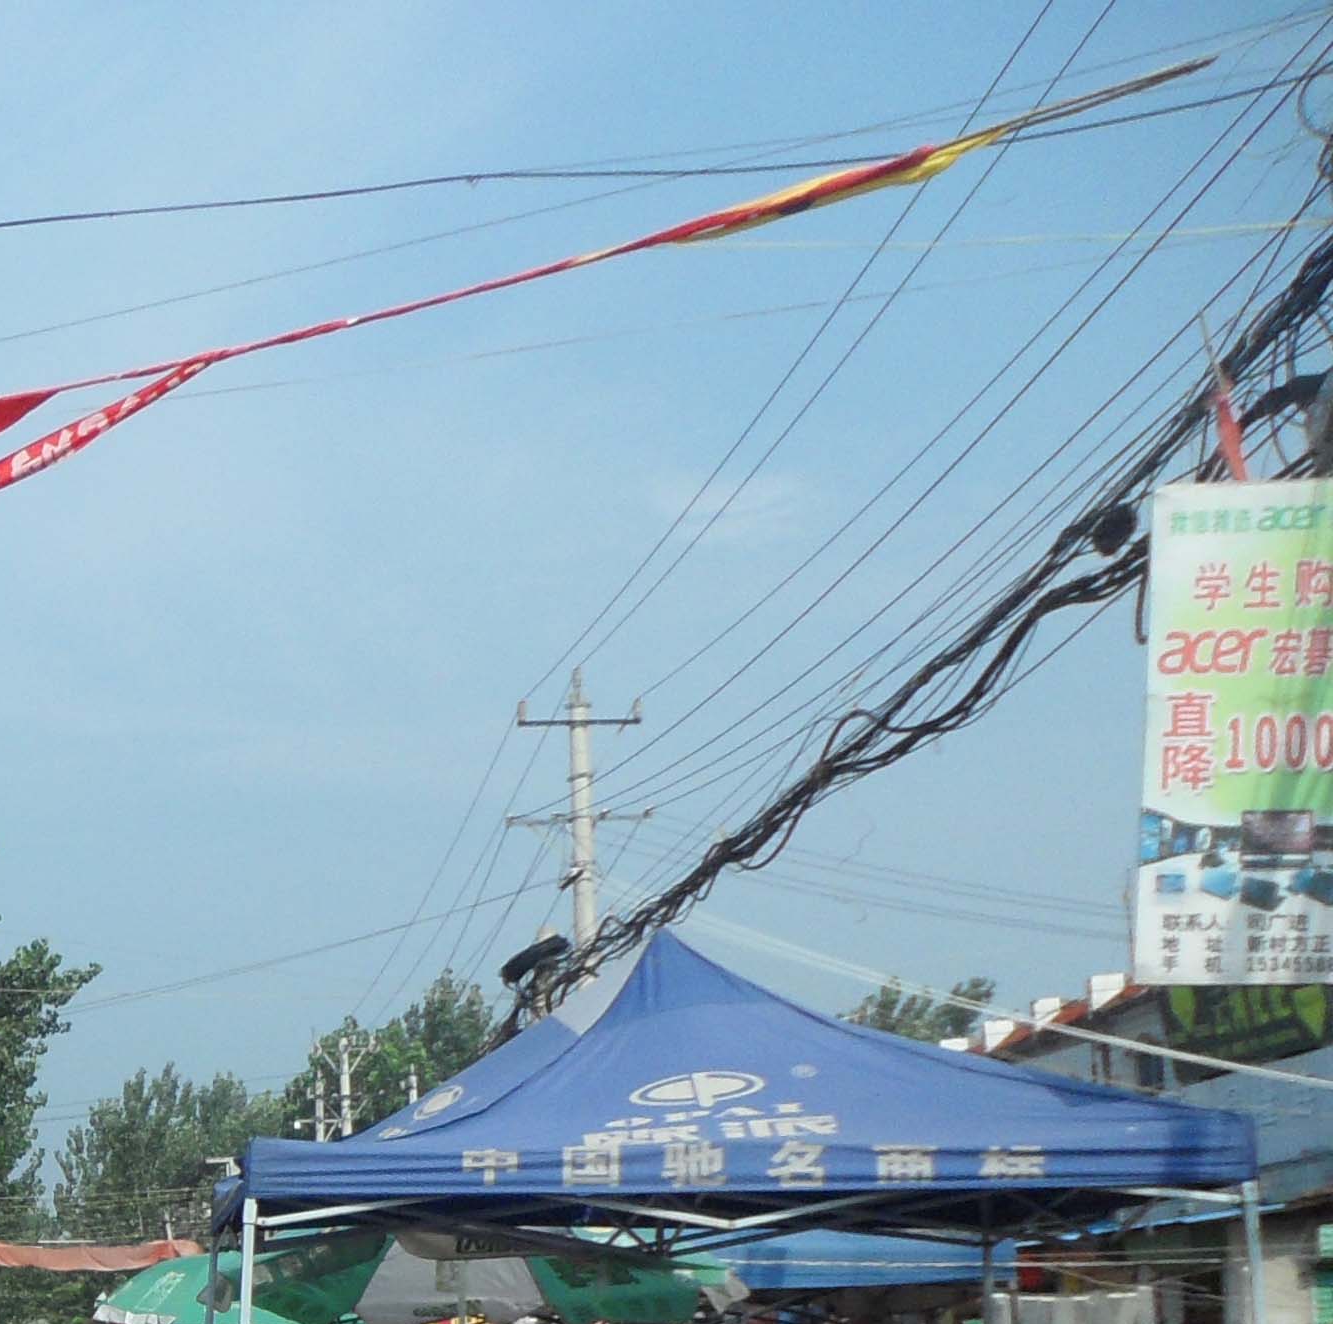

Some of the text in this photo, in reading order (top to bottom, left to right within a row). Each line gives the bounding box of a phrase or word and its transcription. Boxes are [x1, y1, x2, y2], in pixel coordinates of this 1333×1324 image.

[1157, 629, 1269, 674] acer
[1162, 692, 1214, 790] 直降
[1224, 714, 1333, 769] 1000
[462, 1141, 1045, 1188] 中国驰名商标
